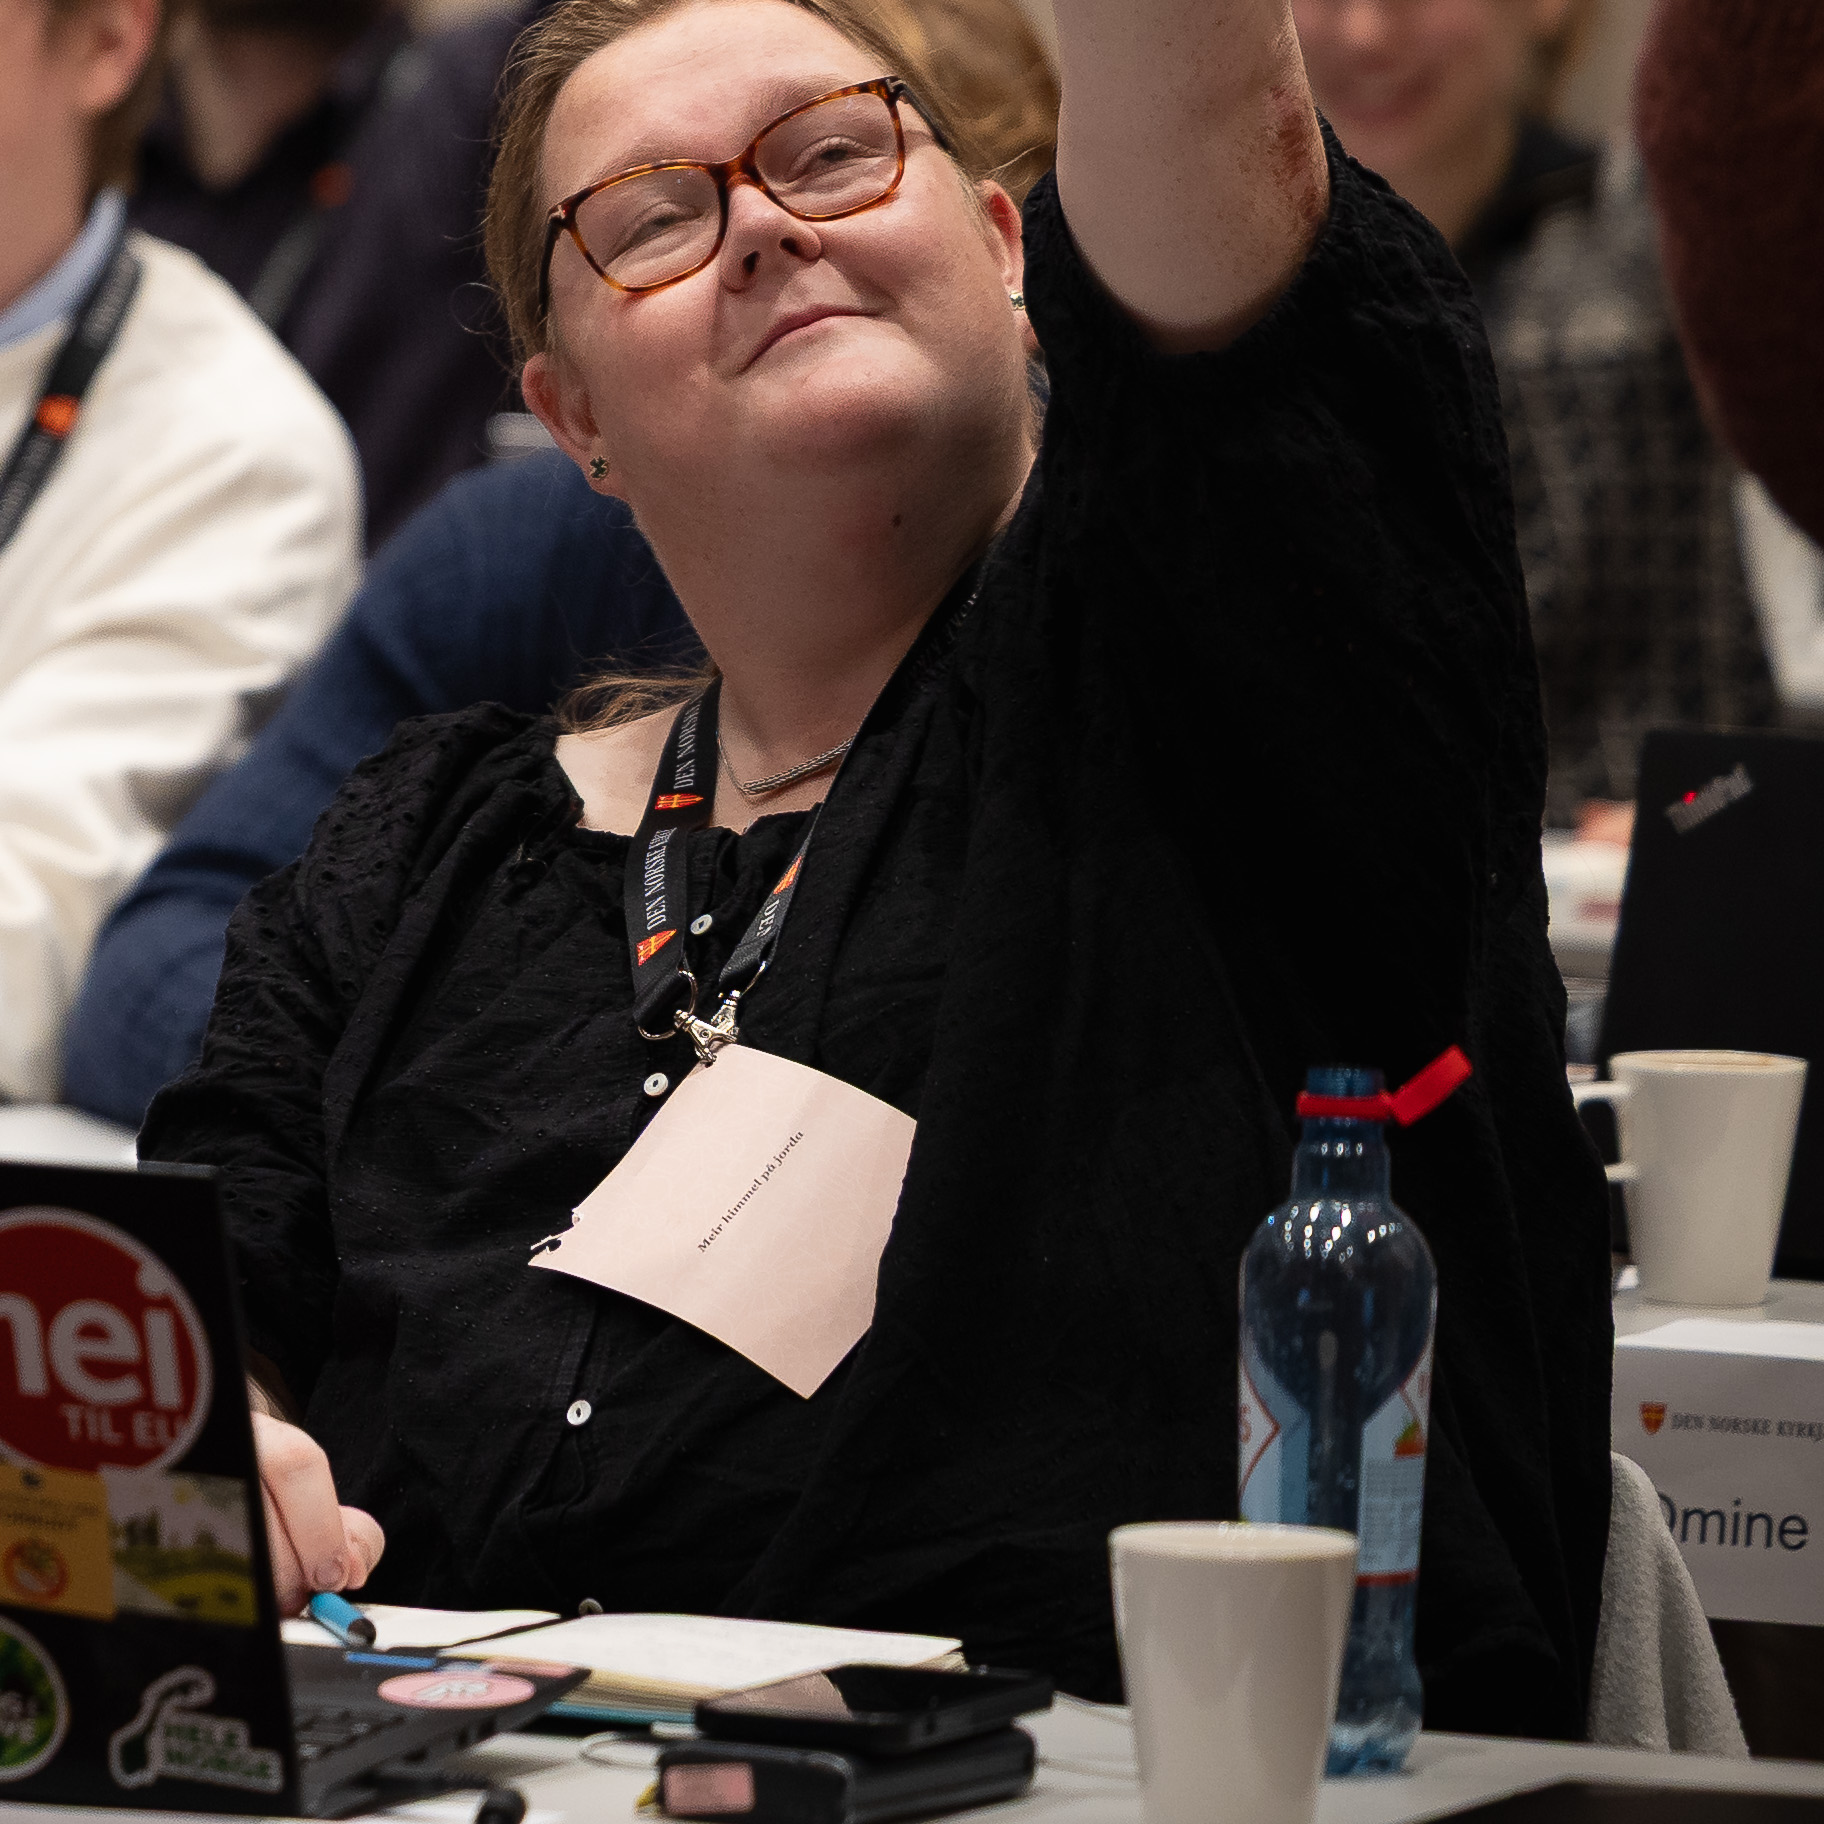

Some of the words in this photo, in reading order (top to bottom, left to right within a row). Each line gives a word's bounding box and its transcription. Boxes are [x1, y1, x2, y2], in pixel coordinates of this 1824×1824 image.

[673, 759, 695, 790] DEN
[646, 895, 667, 931] DEN
[697, 1223, 724, 1253] Meir
[721, 1178, 763, 1224] himmel
[760, 1163, 777, 1182] på
[772, 1131, 804, 1167] jorda
[59, 1403, 125, 1447] TIL
